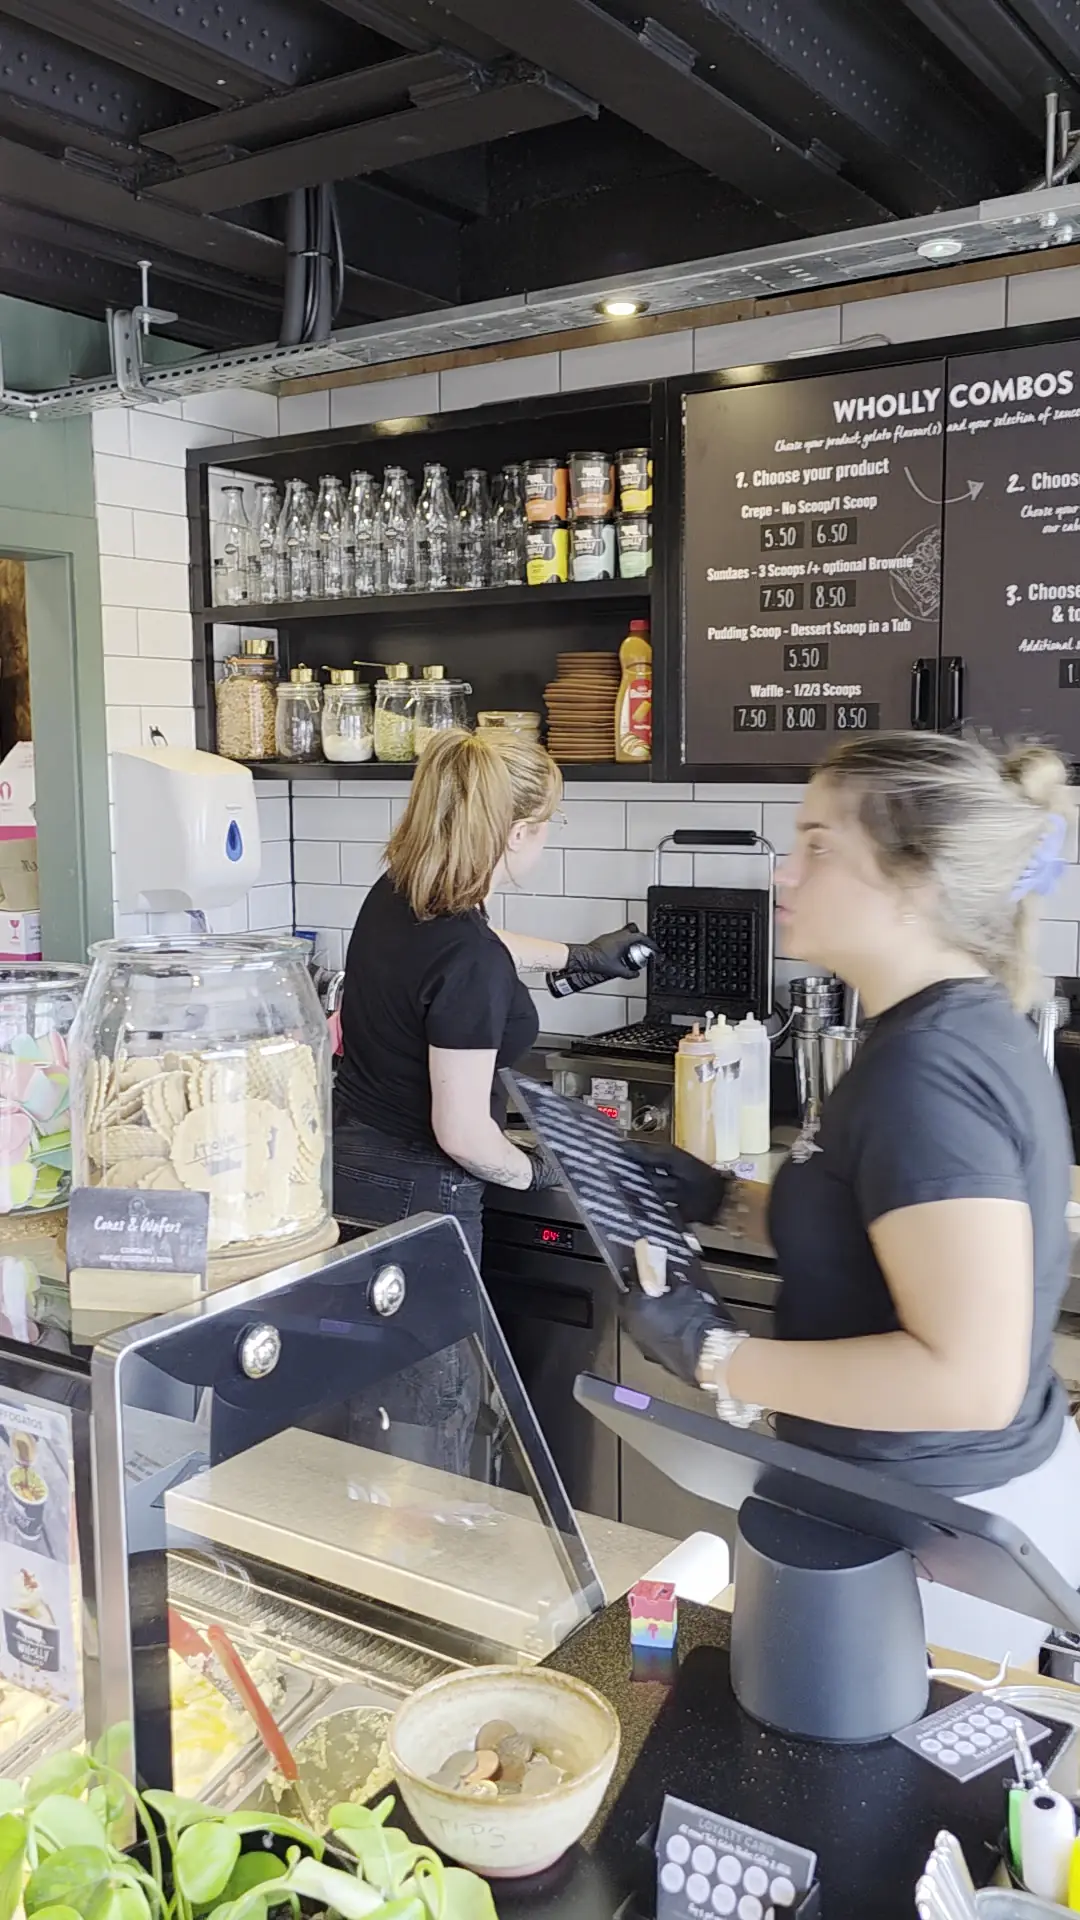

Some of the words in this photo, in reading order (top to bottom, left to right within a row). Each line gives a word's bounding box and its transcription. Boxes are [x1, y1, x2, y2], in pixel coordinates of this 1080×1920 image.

[833, 387, 941, 424] WHOLLY
[949, 370, 1074, 408] COMBOS
[861, 428, 892, 449] gelato
[946, 418, 967, 433] and
[968, 419, 992, 435] your
[993, 411, 1036, 428] selection
[1038, 406, 1052, 426] of
[735, 471, 748, 488] 1.
[752, 470, 800, 487] Choose
[802, 467, 833, 485] your
[836, 458, 889, 482] product
[1006, 473, 1025, 493] 2.
[1031, 472, 1080, 491] Choos
[741, 504, 772, 519] Crepe
[781, 501, 796, 515] No
[843, 495, 878, 510] Scoop
[1020, 504, 1053, 518] Choose
[1055, 505, 1079, 521] your
[764, 526, 797, 549] 5.50
[816, 522, 848, 544] 6.50
[706, 567, 750, 582] Sundaes
[758, 564, 767, 578] 3
[768, 562, 806, 579] Scoops
[822, 557, 867, 574] optional
[868, 555, 914, 570] Brownie
[762, 588, 795, 608] 7.50
[815, 585, 847, 607] 8.50
[1006, 584, 1023, 606] 3.
[1051, 605, 1065, 623] &
[707, 626, 749, 642] Pudding
[749, 624, 782, 641] Scoop
[790, 621, 832, 637] Dessert
[833, 620, 867, 636] Scoop
[868, 619, 880, 633] in
[881, 621, 889, 633] a
[891, 618, 912, 632] Tub
[1018, 637, 1074, 652] Additional
[788, 647, 820, 668] 5.50
[750, 684, 784, 698] Waffle
[793, 683, 821, 697] 1/2/3
[822, 682, 862, 698] Scoops
[738, 708, 767, 728] 7.50
[786, 707, 816, 728] 8.00
[837, 706, 867, 728] 8.50
[94, 1215, 126, 1231] Cones
[127, 1217, 140, 1232] &
[140, 1216, 182, 1238] Wafers
[430, 1815, 507, 1849] TIPS
